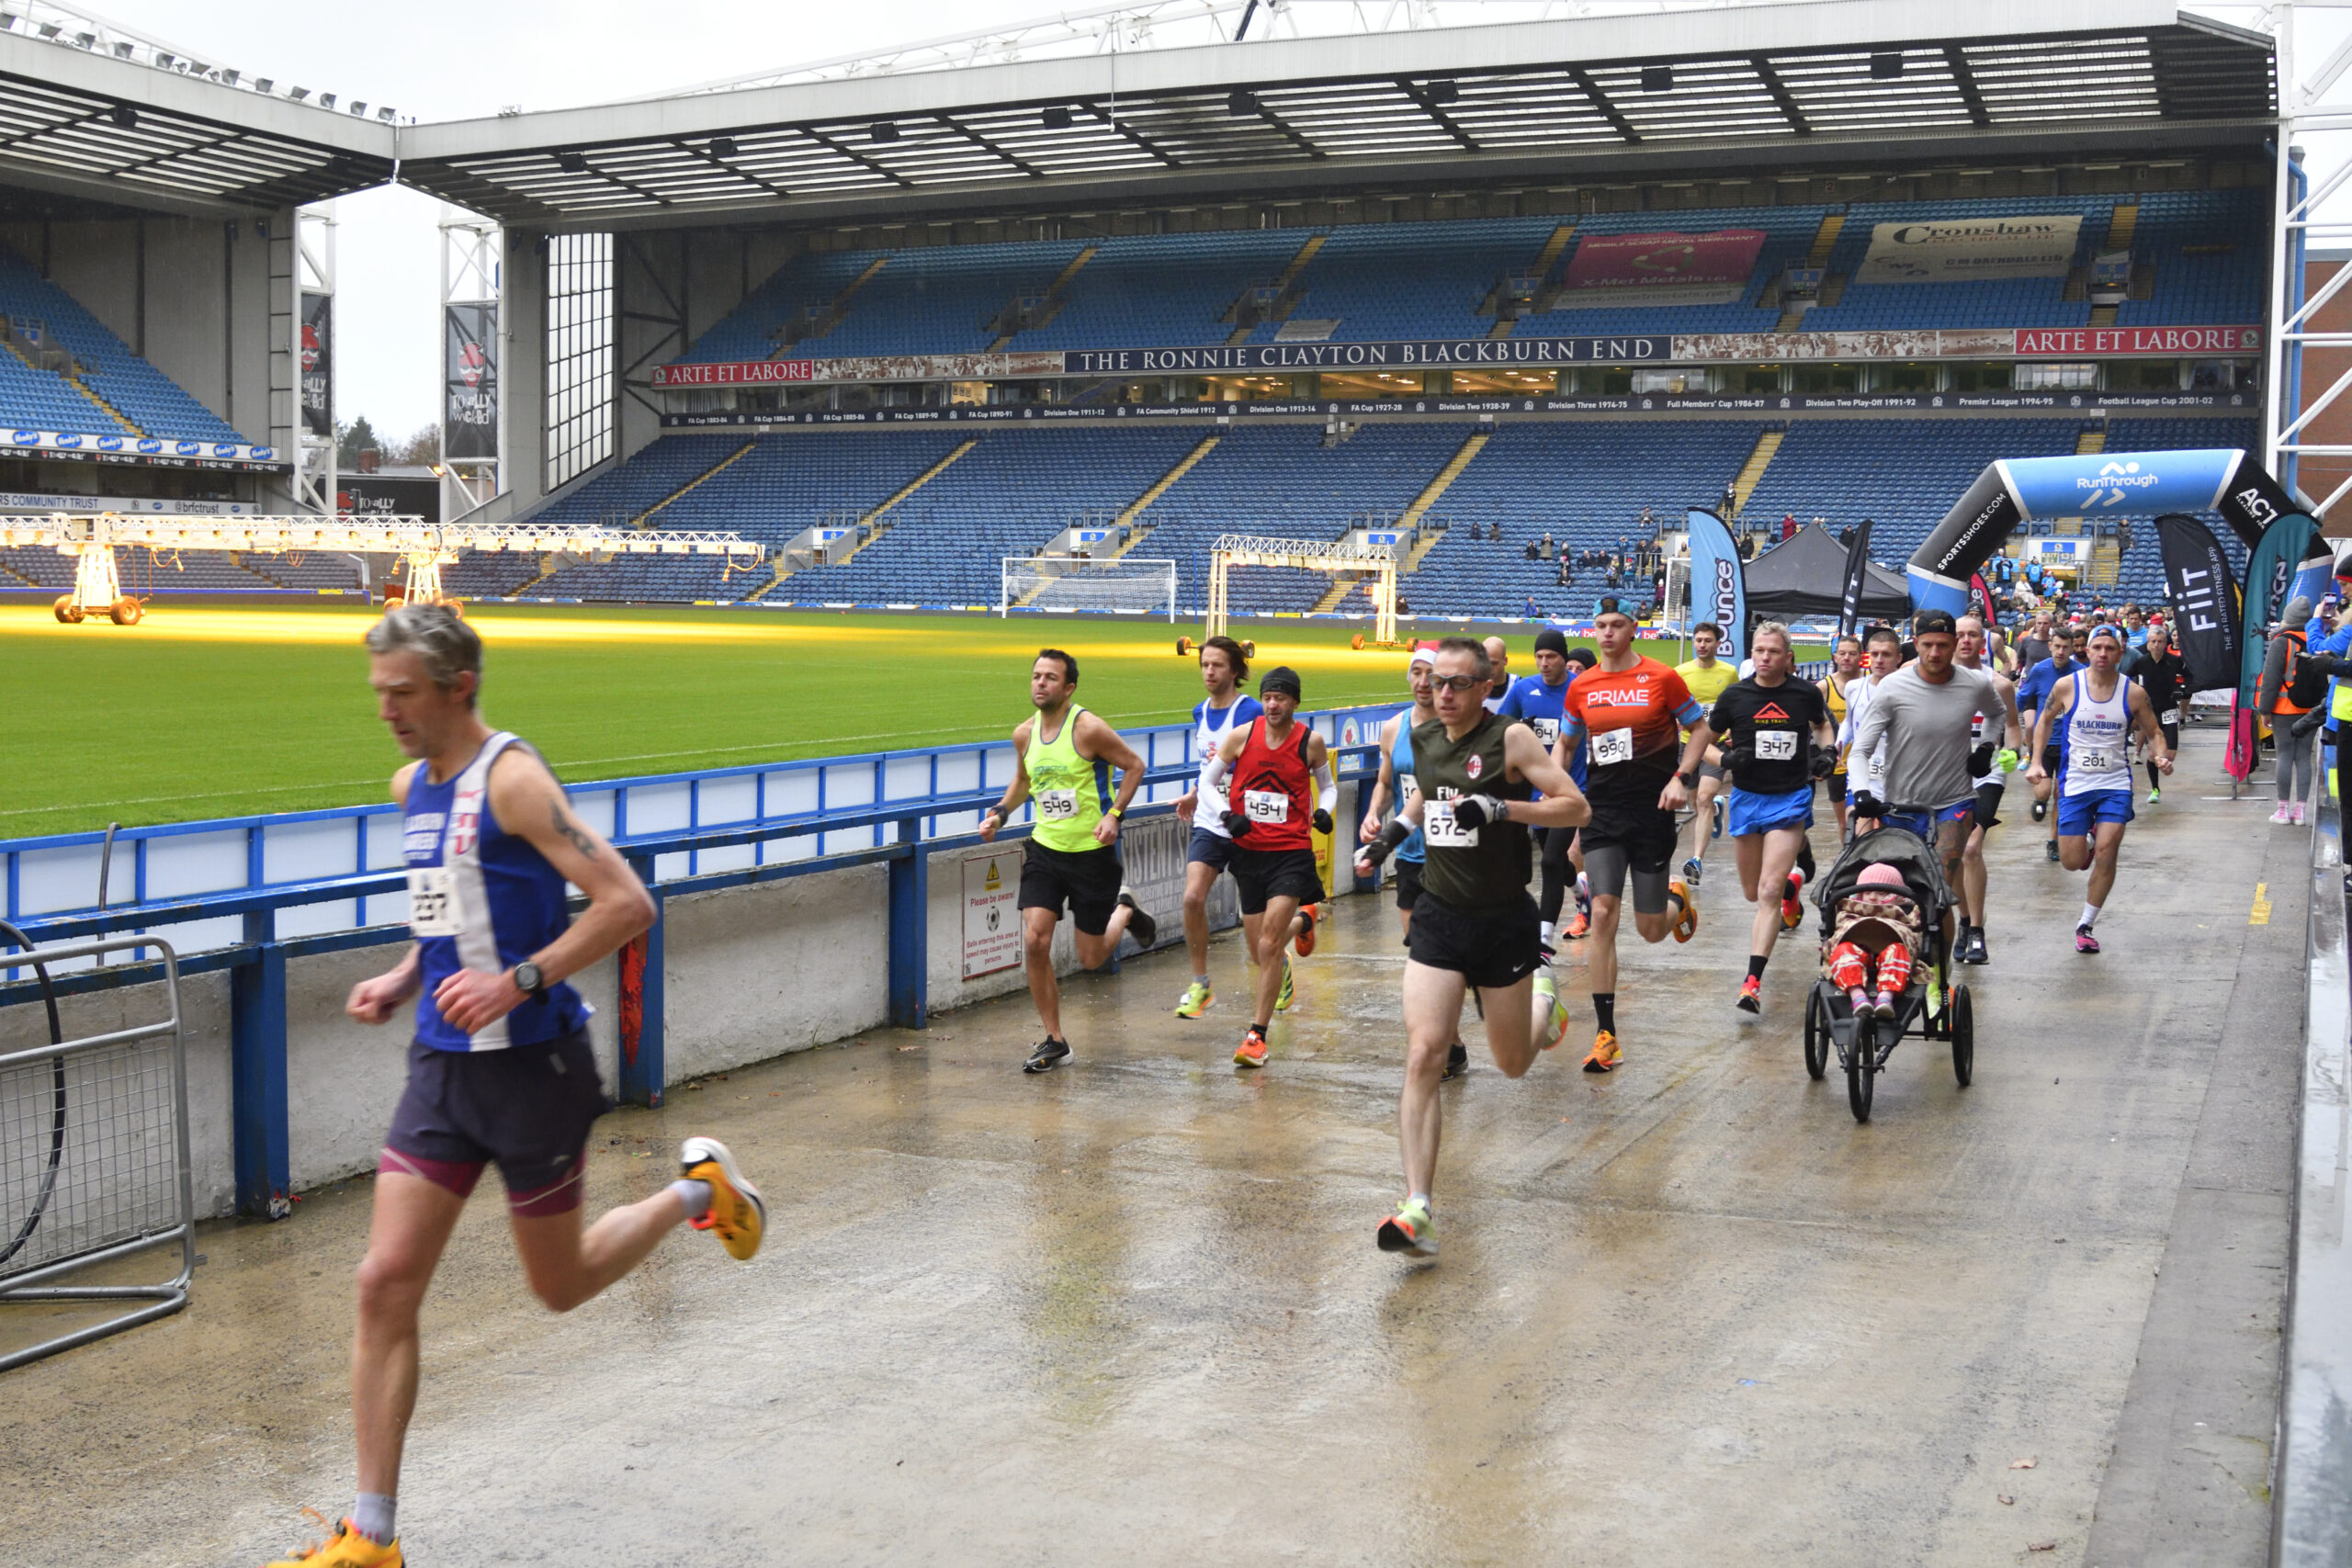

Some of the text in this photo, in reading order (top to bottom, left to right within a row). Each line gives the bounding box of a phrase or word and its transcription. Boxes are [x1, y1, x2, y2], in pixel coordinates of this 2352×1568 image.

[1893, 223, 2055, 244] Cronshaw
[2021, 330, 2234, 351] ARTE ET LABORE
[1080, 339, 1653, 370] THE RONNIE CLAYTON BLACKBURN END
[671, 362, 809, 383] ARTE ET LABORE
[1718, 400, 1732, 409] Cup
[2132, 398, 2159, 406] League
[2076, 473, 2158, 489] RunThrough
[12, 496, 67, 509] COMMUNITY
[70, 497, 98, 510] TRUST
[1937, 492, 2007, 570] SPORTSSHOES.COM
[2208, 546, 2220, 562] APP
[2211, 563, 2224, 595] FITNESS
[2217, 596, 2229, 623] RATED
[1563, 628, 1597, 637] sky be
[2224, 635, 2233, 651] THE
[1588, 689, 1649, 706] PRIME
[2076, 720, 2122, 730] BLACKBURN
[1534, 728, 1553, 739] 04
[1599, 741, 1625, 758] 990
[1762, 740, 1792, 753] 347
[2082, 756, 2106, 767] 201
[1043, 800, 1072, 814] 549
[1250, 801, 1280, 817] 434
[970, 890, 1015, 908] Please be aware!
[967, 940, 978, 949] Balls
[978, 935, 996, 946] entering
[966, 949, 979, 960] speed
[979, 947, 989, 956] may
[989, 944, 1002, 953] cause
